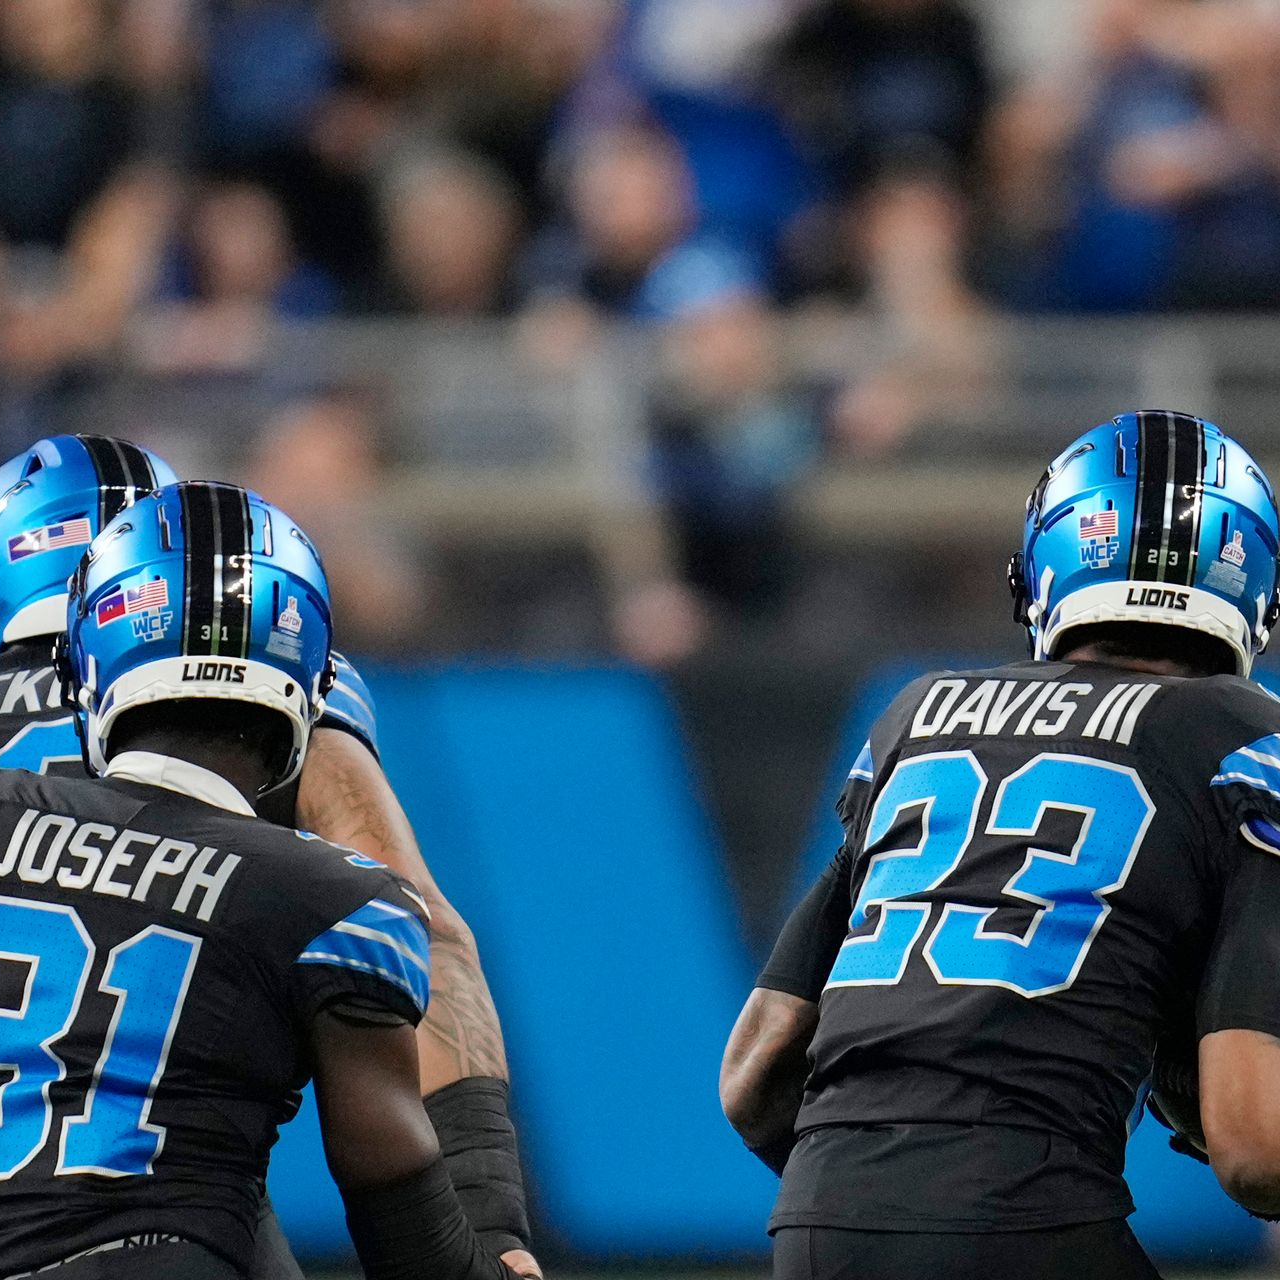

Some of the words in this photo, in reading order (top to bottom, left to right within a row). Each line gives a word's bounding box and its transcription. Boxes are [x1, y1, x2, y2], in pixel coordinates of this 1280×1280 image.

[1081, 542, 1118, 563] WCF
[1148, 549, 1178, 566] 23
[1126, 588, 1189, 611] LIONS
[132, 612, 172, 637] WCF
[201, 625, 228, 641] 31
[182, 662, 246, 684] LIONS
[909, 677, 1094, 739] DAVIS
[1081, 683, 1162, 746] III
[819, 750, 1157, 1000] 23
